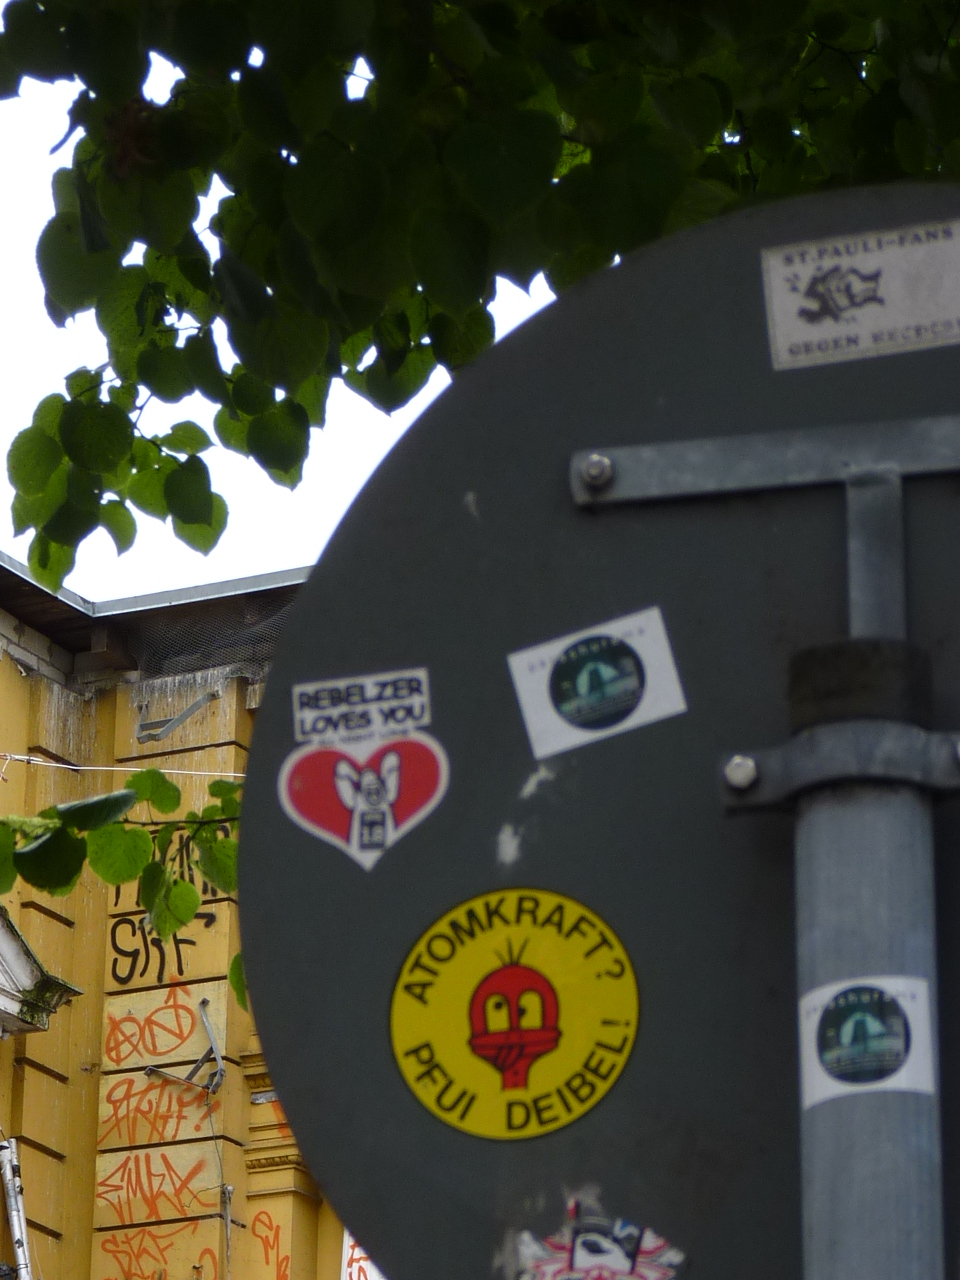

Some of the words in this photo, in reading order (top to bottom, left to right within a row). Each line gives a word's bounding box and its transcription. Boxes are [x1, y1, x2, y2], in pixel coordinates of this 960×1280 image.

[298, 677, 424, 711] REBELZER
[300, 710, 372, 736] LOVES
[378, 702, 426, 725] YOU
[403, 895, 625, 1006] ATOMKRAFT?
[404, 1041, 477, 1123] PFUI
[505, 1017, 632, 1131] DEIBEL!
